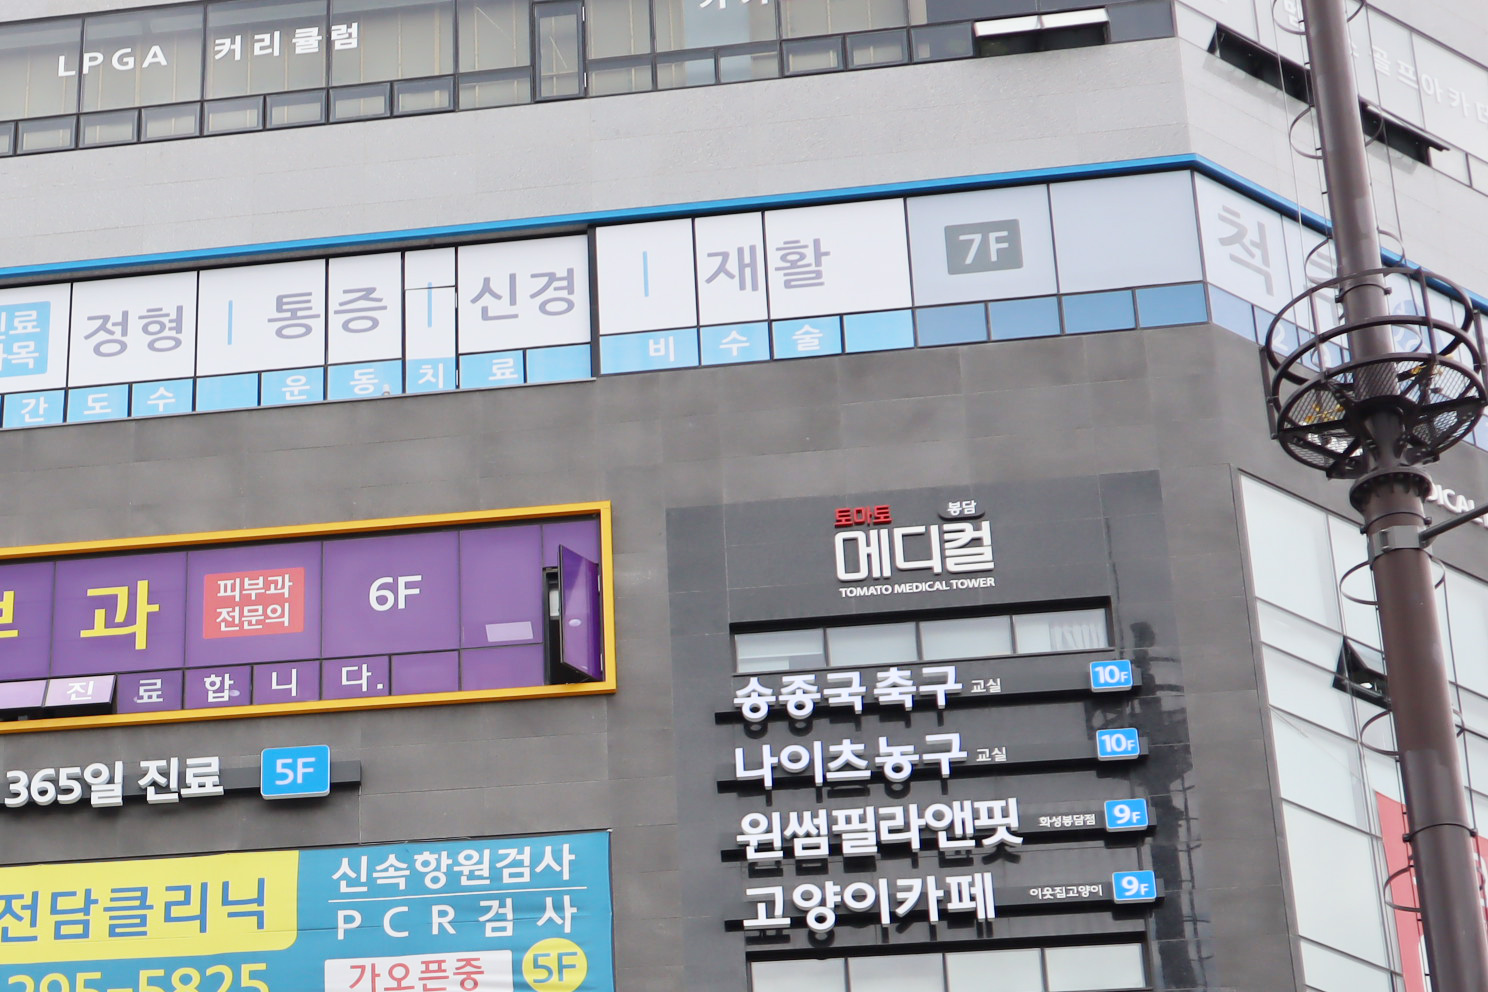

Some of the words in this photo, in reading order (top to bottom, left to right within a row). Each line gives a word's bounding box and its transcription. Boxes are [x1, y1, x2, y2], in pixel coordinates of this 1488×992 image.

[214, 21, 360, 62] 커리큘럼
[58, 44, 169, 78] LPGA
[958, 230, 1009, 265] 7F
[83, 304, 184, 358] 정형
[266, 286, 388, 340] 통증
[469, 268, 576, 323] 신경
[704, 236, 831, 292] 재활
[648, 324, 824, 363] 비수술
[835, 505, 892, 527] 토마토
[948, 500, 977, 516] 봉담
[835, 521, 994, 582] 메디컬
[216, 574, 293, 601] 피부과
[369, 574, 423, 612] 6F
[840, 584, 892, 598] TOMATO
[894, 580, 950, 594] MEDICAL
[950, 577, 995, 590] TOWER
[216, 602, 290, 631] 전문의
[970, 678, 1001, 693] 교실
[1094, 665, 1128, 684] 10F
[1101, 733, 1135, 752] 10F
[275, 757, 315, 786] 5F
[734, 733, 967, 789] 나이츠농구
[976, 747, 1007, 761] 교실
[4, 760, 123, 809] 365일
[138, 756, 224, 804] 진료
[1038, 814, 1096, 827] 화성봉담점
[1113, 804, 1141, 824] 9F
[332, 843, 575, 893] 신속항원검사
[1121, 876, 1149, 896] 9F
[743, 872, 995, 933] 고양이카페
[1030, 885, 1102, 899] 이웃집고양이
[533, 951, 578, 983] 5F
